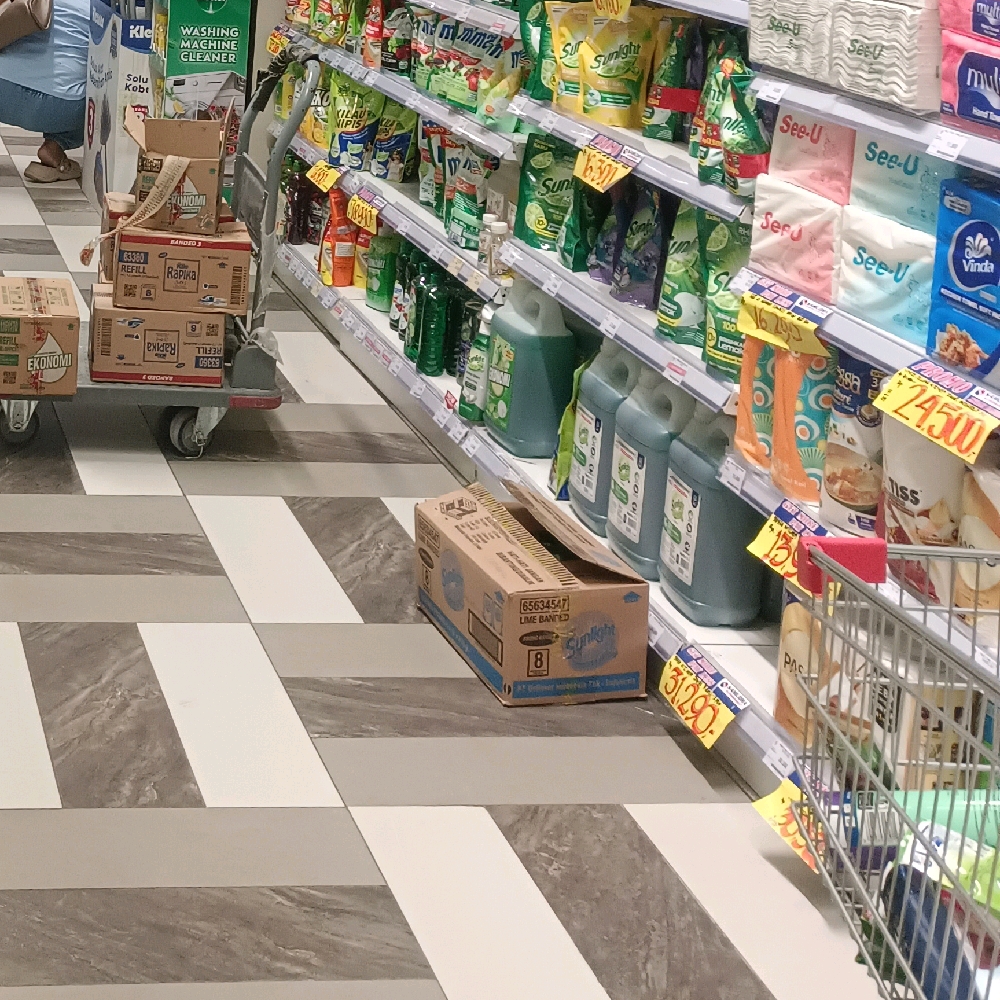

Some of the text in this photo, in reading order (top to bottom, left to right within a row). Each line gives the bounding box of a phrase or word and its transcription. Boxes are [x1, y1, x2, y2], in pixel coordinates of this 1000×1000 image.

[180, 26, 239, 37] WASHING
[768, 15, 800, 36] See-U
[180, 40, 238, 50] MACHINE
[849, 38, 884, 61] See-U
[180, 53, 237, 63] CLEANER
[590, 41, 641, 69] Sunlight
[780, 114, 822, 144] See-U
[865, 141, 920, 175] See-U
[760, 211, 803, 242] See-U
[120, 265, 147, 274] REFILL
[853, 245, 910, 283] See-U
[962, 259, 995, 273] Vinda
[166, 266, 197, 280] Rapika
[147, 341, 176, 356] Rapika
[196, 346, 222, 354] REFILL
[27, 353, 73, 371] EKONOMI
[911, 361, 973, 393] PROMO
[520, 615, 537, 624] LIME
[565, 624, 616, 660] Sunlight
[534, 651, 543, 668] 8
